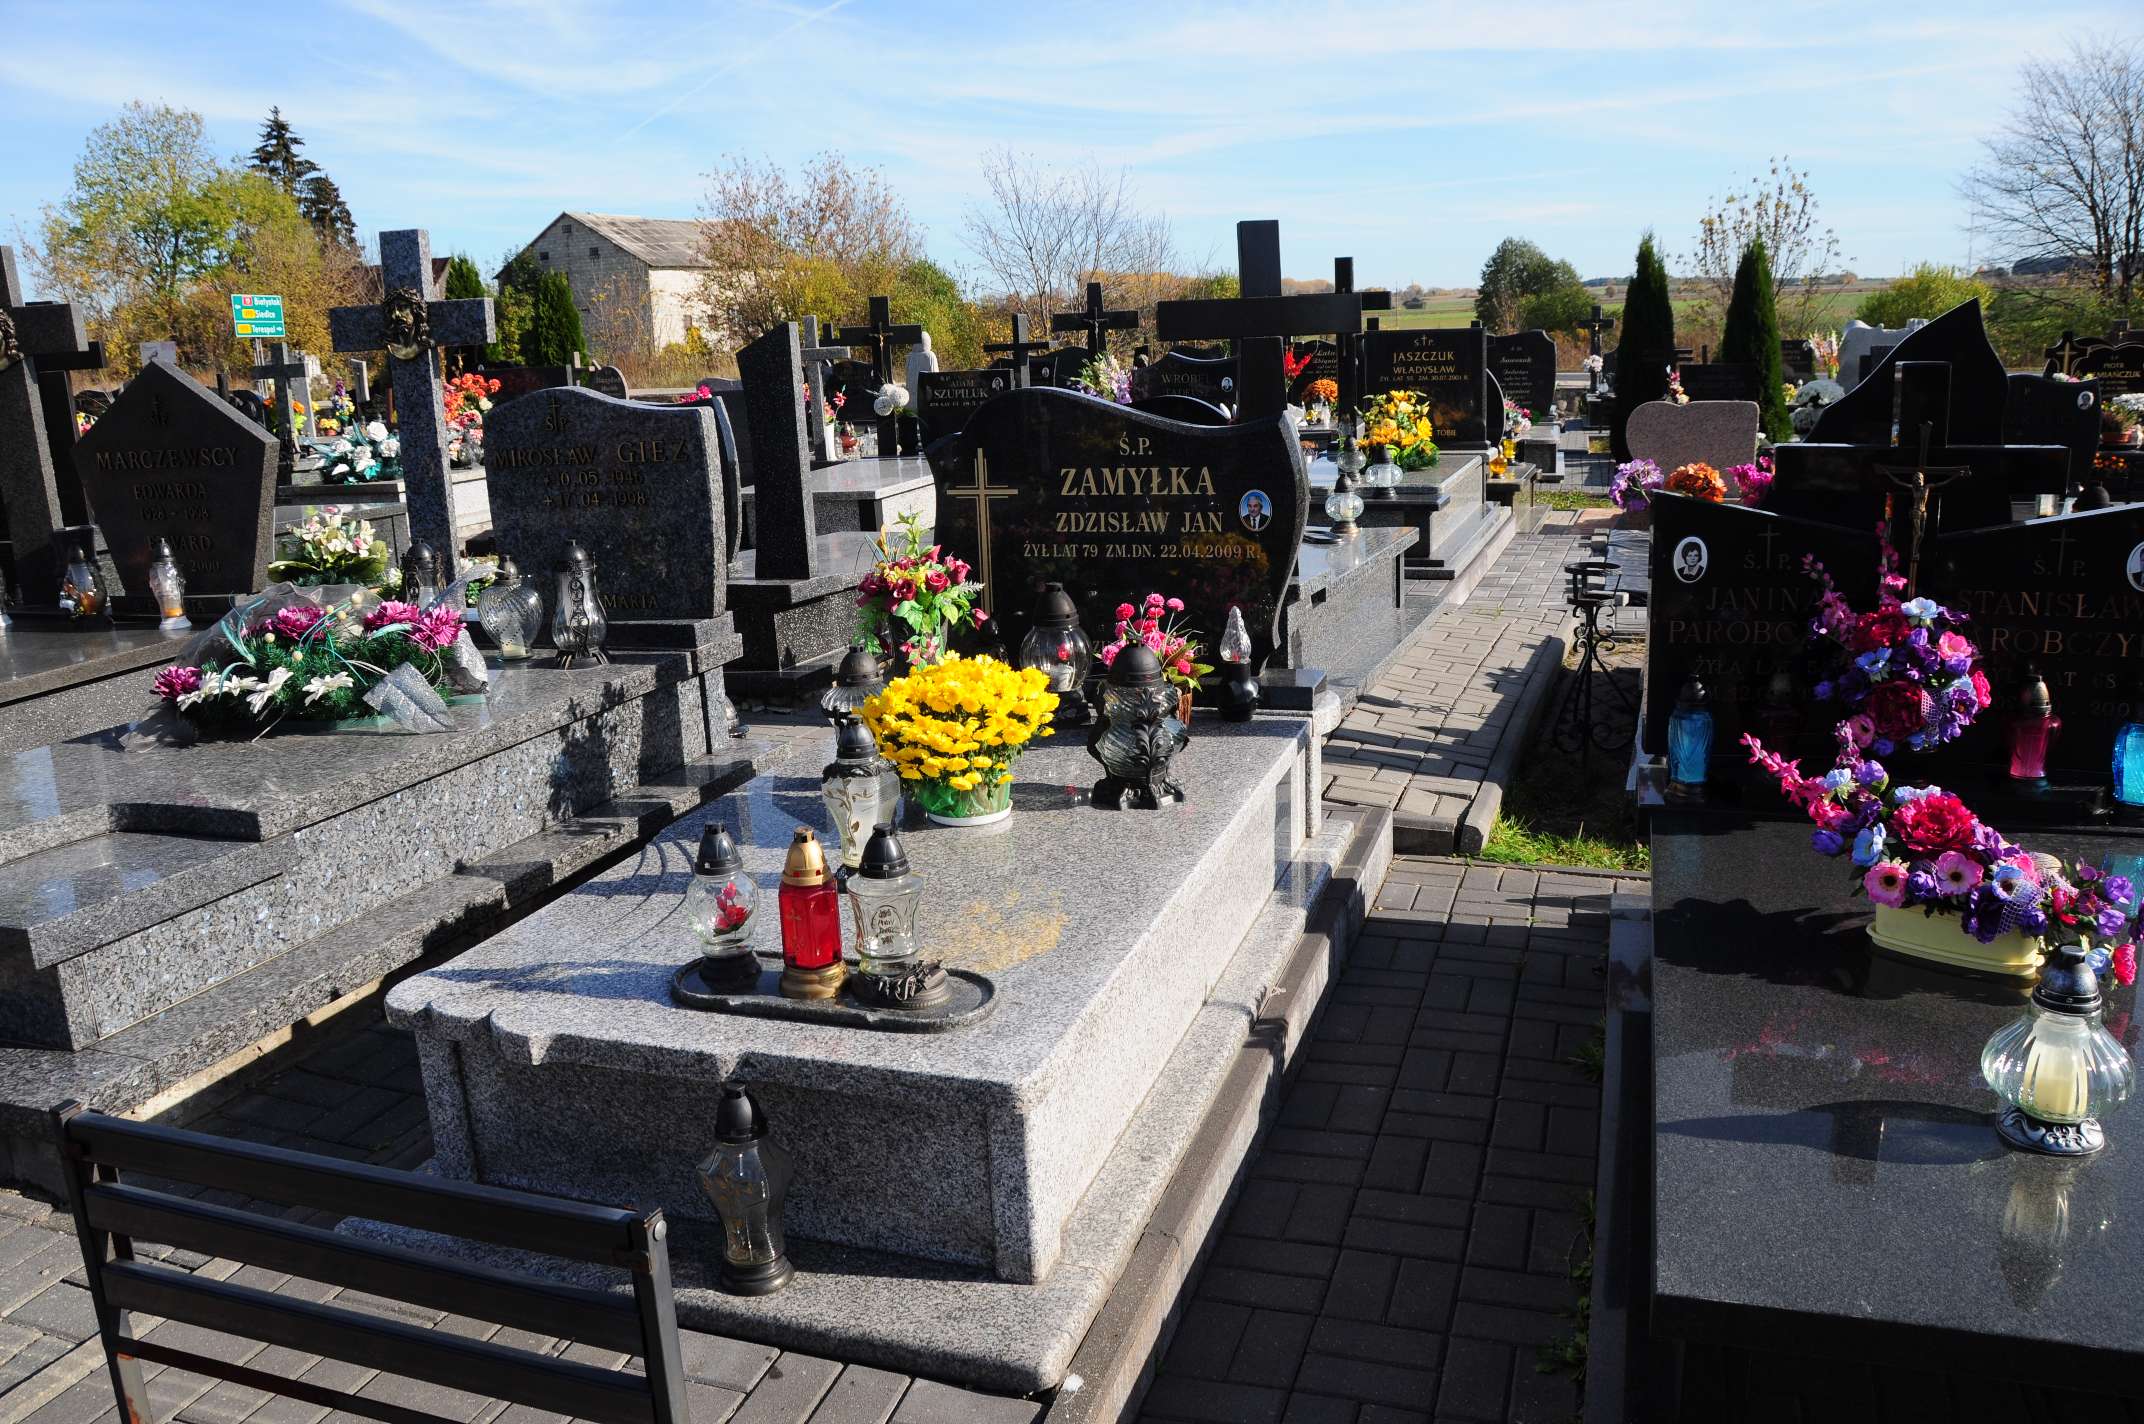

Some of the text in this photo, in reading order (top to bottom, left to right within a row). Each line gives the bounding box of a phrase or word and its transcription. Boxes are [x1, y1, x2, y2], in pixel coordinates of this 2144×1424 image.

[1393, 351, 1455, 363] JASZCZUK
[1393, 365, 1456, 375] WŁADYSŁAW
[96, 447, 238, 471] MARCZEWSCY
[1060, 466, 1217, 496] ZAMYŁKA
[1056, 511, 1224, 533] ZDZISŁAW JAN
[1023, 540, 1050, 558] ŻYŁ
[1053, 543, 1079, 558] LAT
[1082, 543, 1099, 558] 79
[1160, 543, 1242, 559] 22.04.2009
